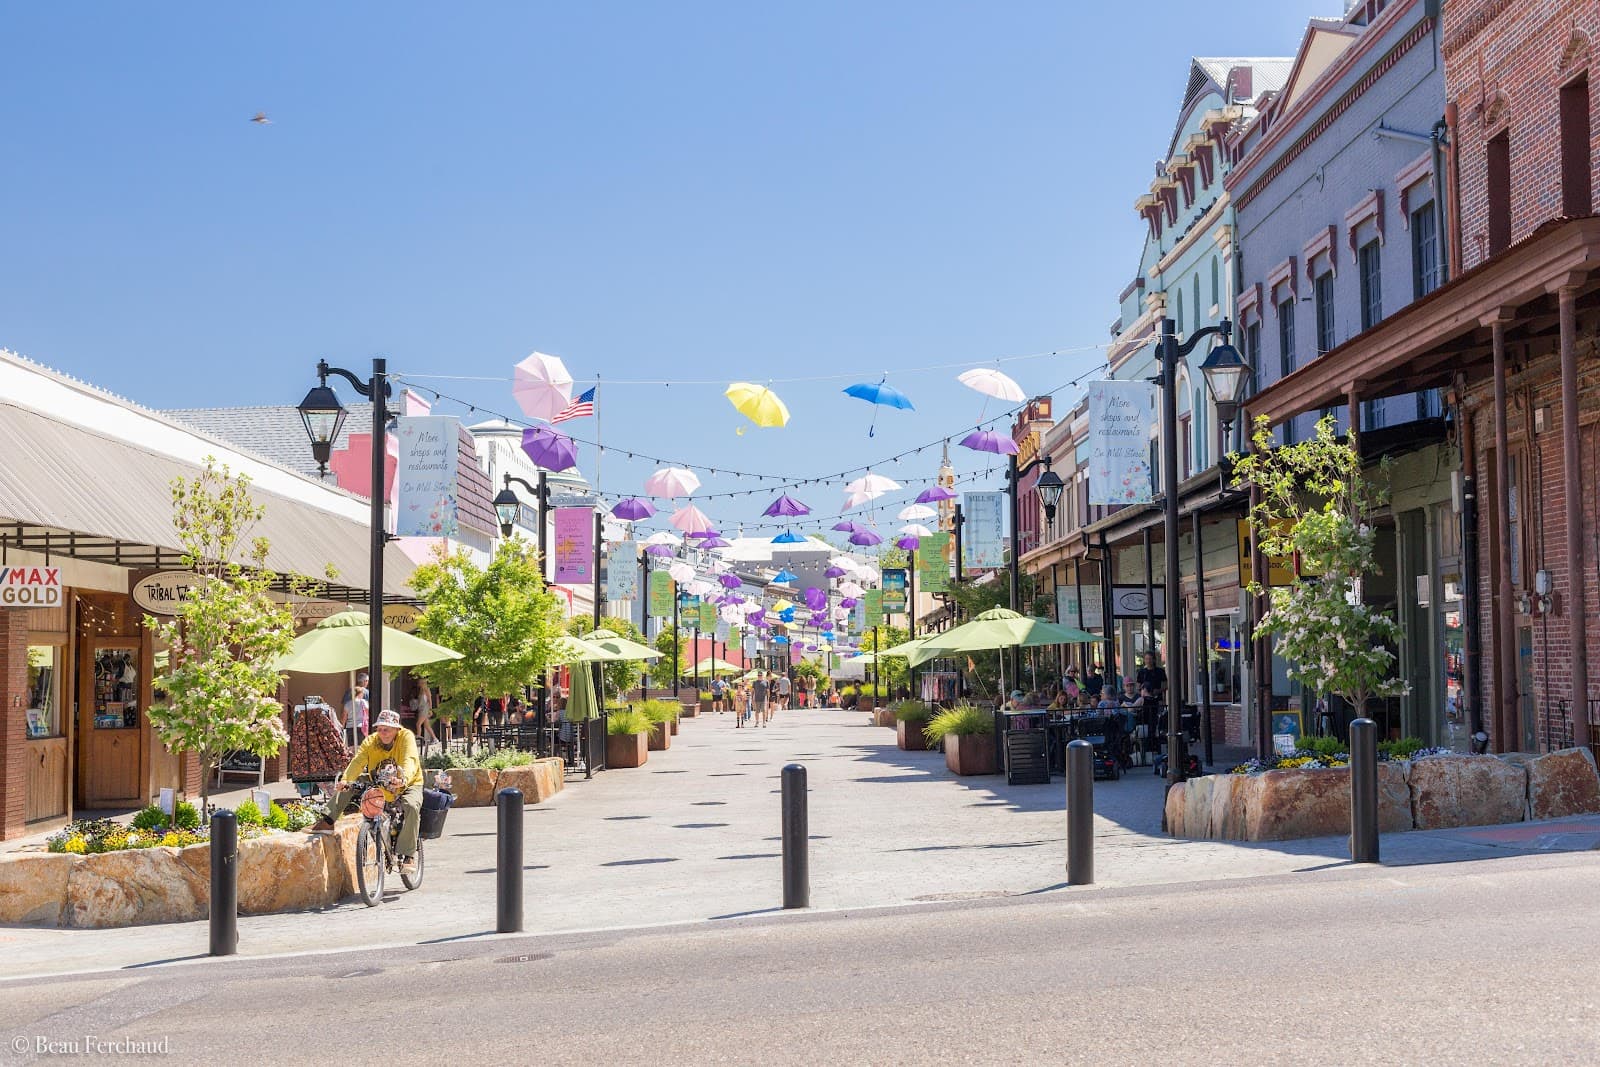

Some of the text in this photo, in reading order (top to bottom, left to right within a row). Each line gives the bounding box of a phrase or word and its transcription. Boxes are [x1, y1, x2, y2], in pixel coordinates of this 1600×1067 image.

[1108, 396, 1130, 408] More
[1100, 408, 1142, 429] shops and
[418, 432, 439, 442] More
[410, 443, 448, 465] shops and
[408, 459, 448, 471] restaurants
[2, 587, 58, 604] GOLD
